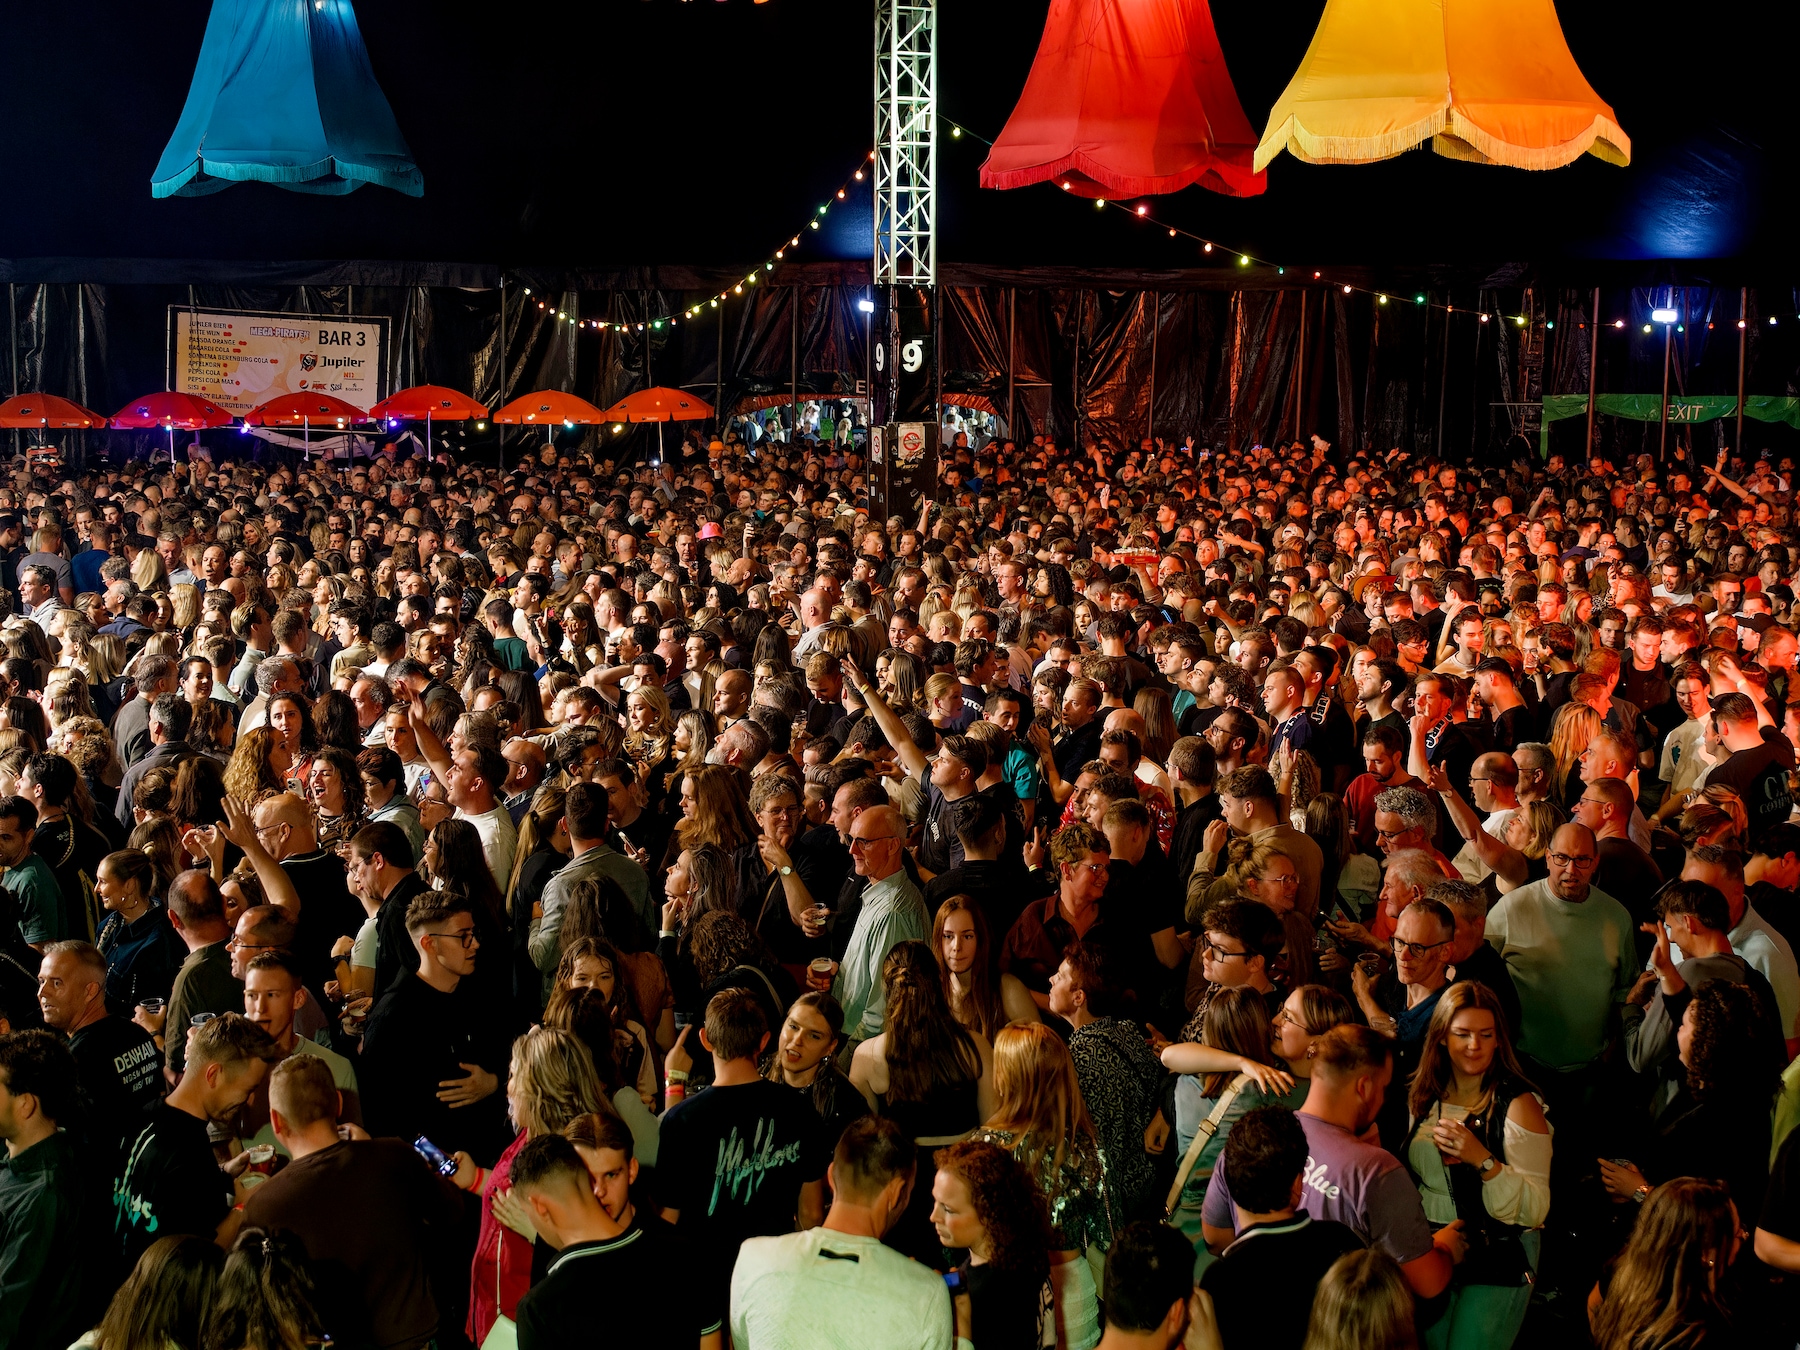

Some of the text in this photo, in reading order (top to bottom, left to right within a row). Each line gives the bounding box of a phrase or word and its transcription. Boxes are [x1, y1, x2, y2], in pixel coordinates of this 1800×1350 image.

[318, 329, 366, 347] BAR 3
[319, 356, 365, 369] Jupiler
[875, 342, 885, 372] 9
[205, 369, 221, 377] COLA
[1666, 404, 1704, 420] EXIT
[114, 1040, 156, 1074] DENHAM
